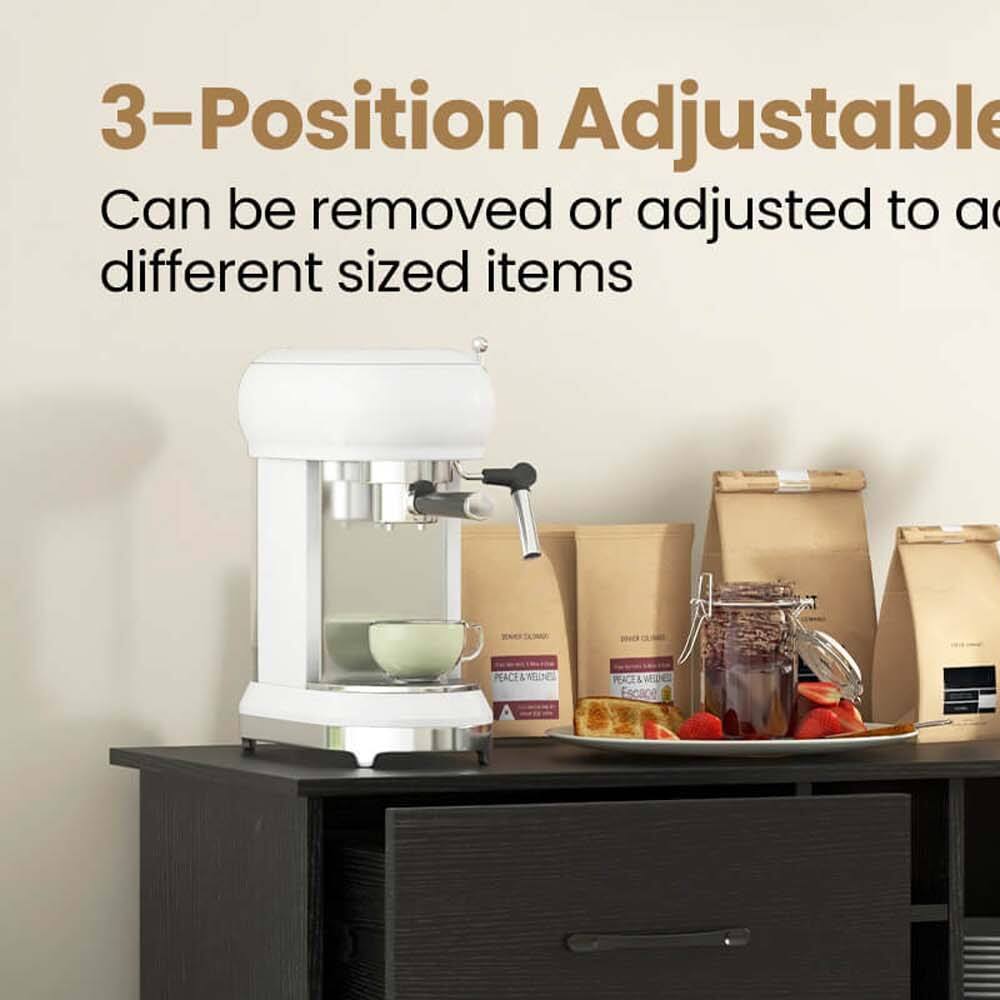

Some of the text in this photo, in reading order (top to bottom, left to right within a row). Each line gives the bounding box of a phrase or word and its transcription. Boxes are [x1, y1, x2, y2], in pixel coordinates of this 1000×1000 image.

[493, 671, 519, 682] PEACE
[520, 671, 526, 681] &
[612, 674, 636, 685] PEACE
